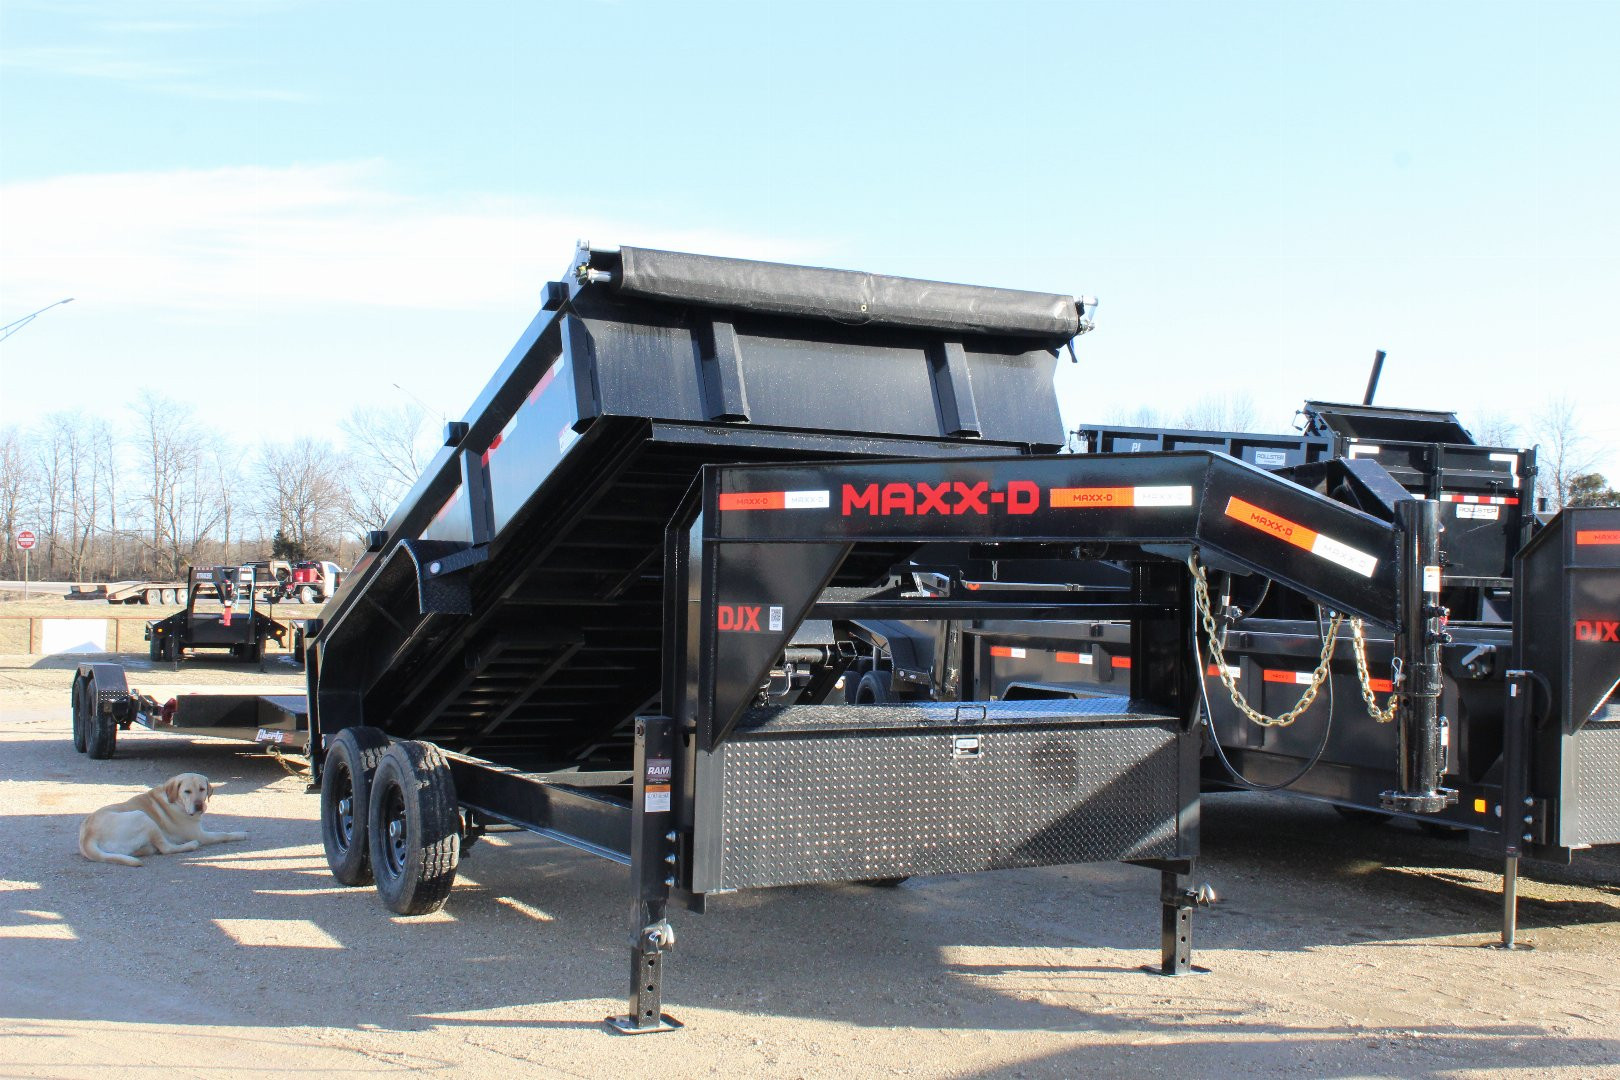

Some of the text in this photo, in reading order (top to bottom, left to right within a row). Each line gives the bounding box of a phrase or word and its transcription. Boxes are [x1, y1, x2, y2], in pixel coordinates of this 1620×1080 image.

[736, 497, 769, 506] MAXX-D
[791, 495, 824, 504] MAXX-D
[842, 480, 1040, 516] MAXX-D
[1072, 493, 1113, 502] MAXX-D
[1250, 512, 1293, 537] MAXX-D
[717, 605, 762, 632] DJX
[1575, 620, 1620, 643] DJX
[255, 728, 284, 743] Liberty
[647, 766, 670, 775] RAM
